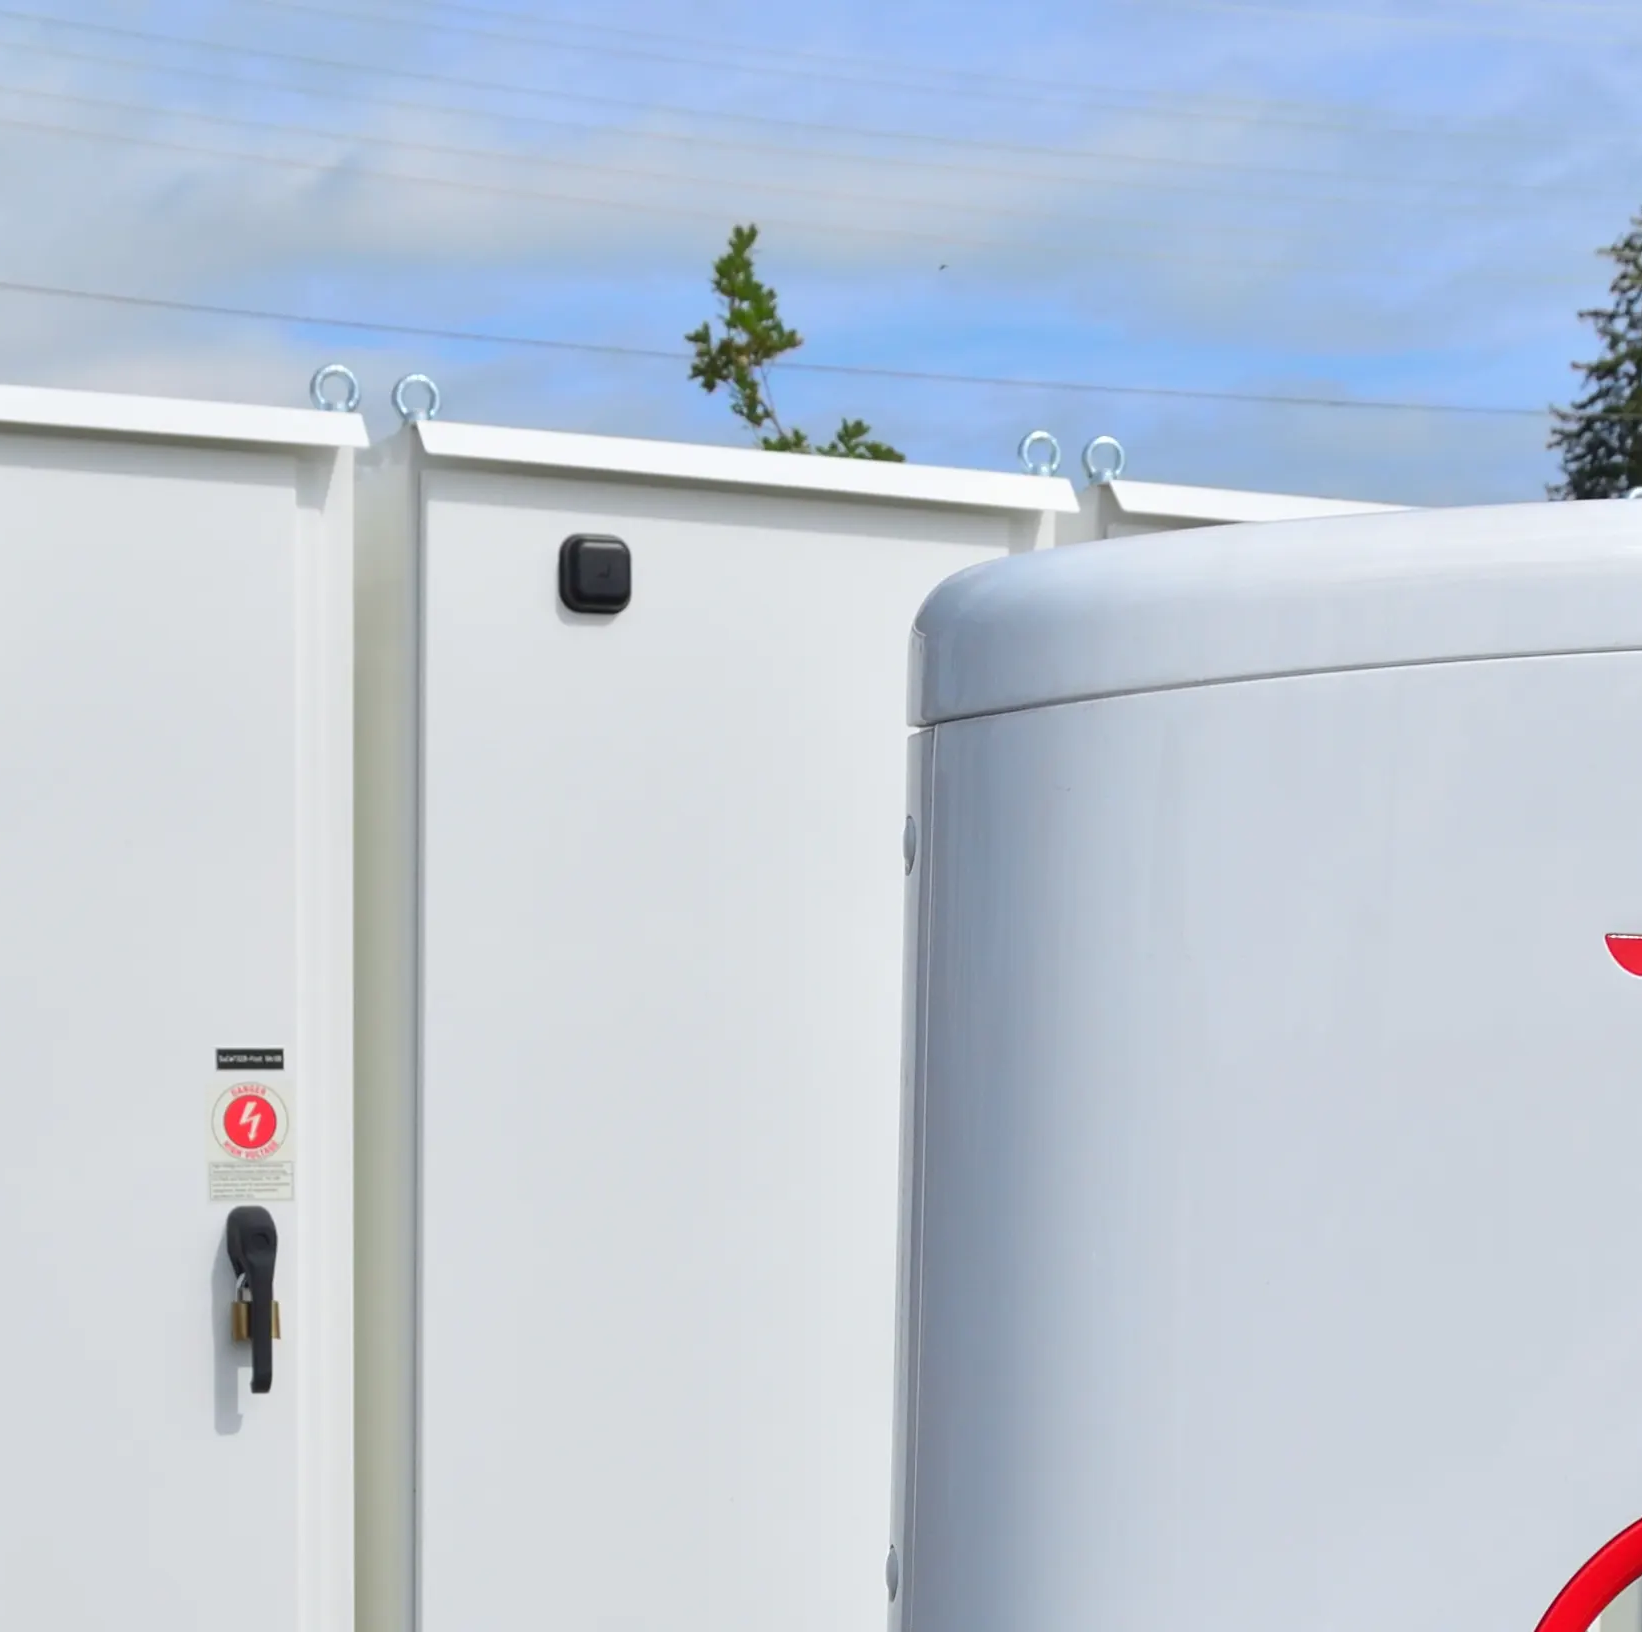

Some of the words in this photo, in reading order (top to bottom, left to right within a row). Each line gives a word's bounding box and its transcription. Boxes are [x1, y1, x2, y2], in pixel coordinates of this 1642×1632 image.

[230, 1085, 267, 1097] DANGER
[223, 1140, 242, 1156] HIGH
[245, 1140, 279, 1160] VOLTAGE
